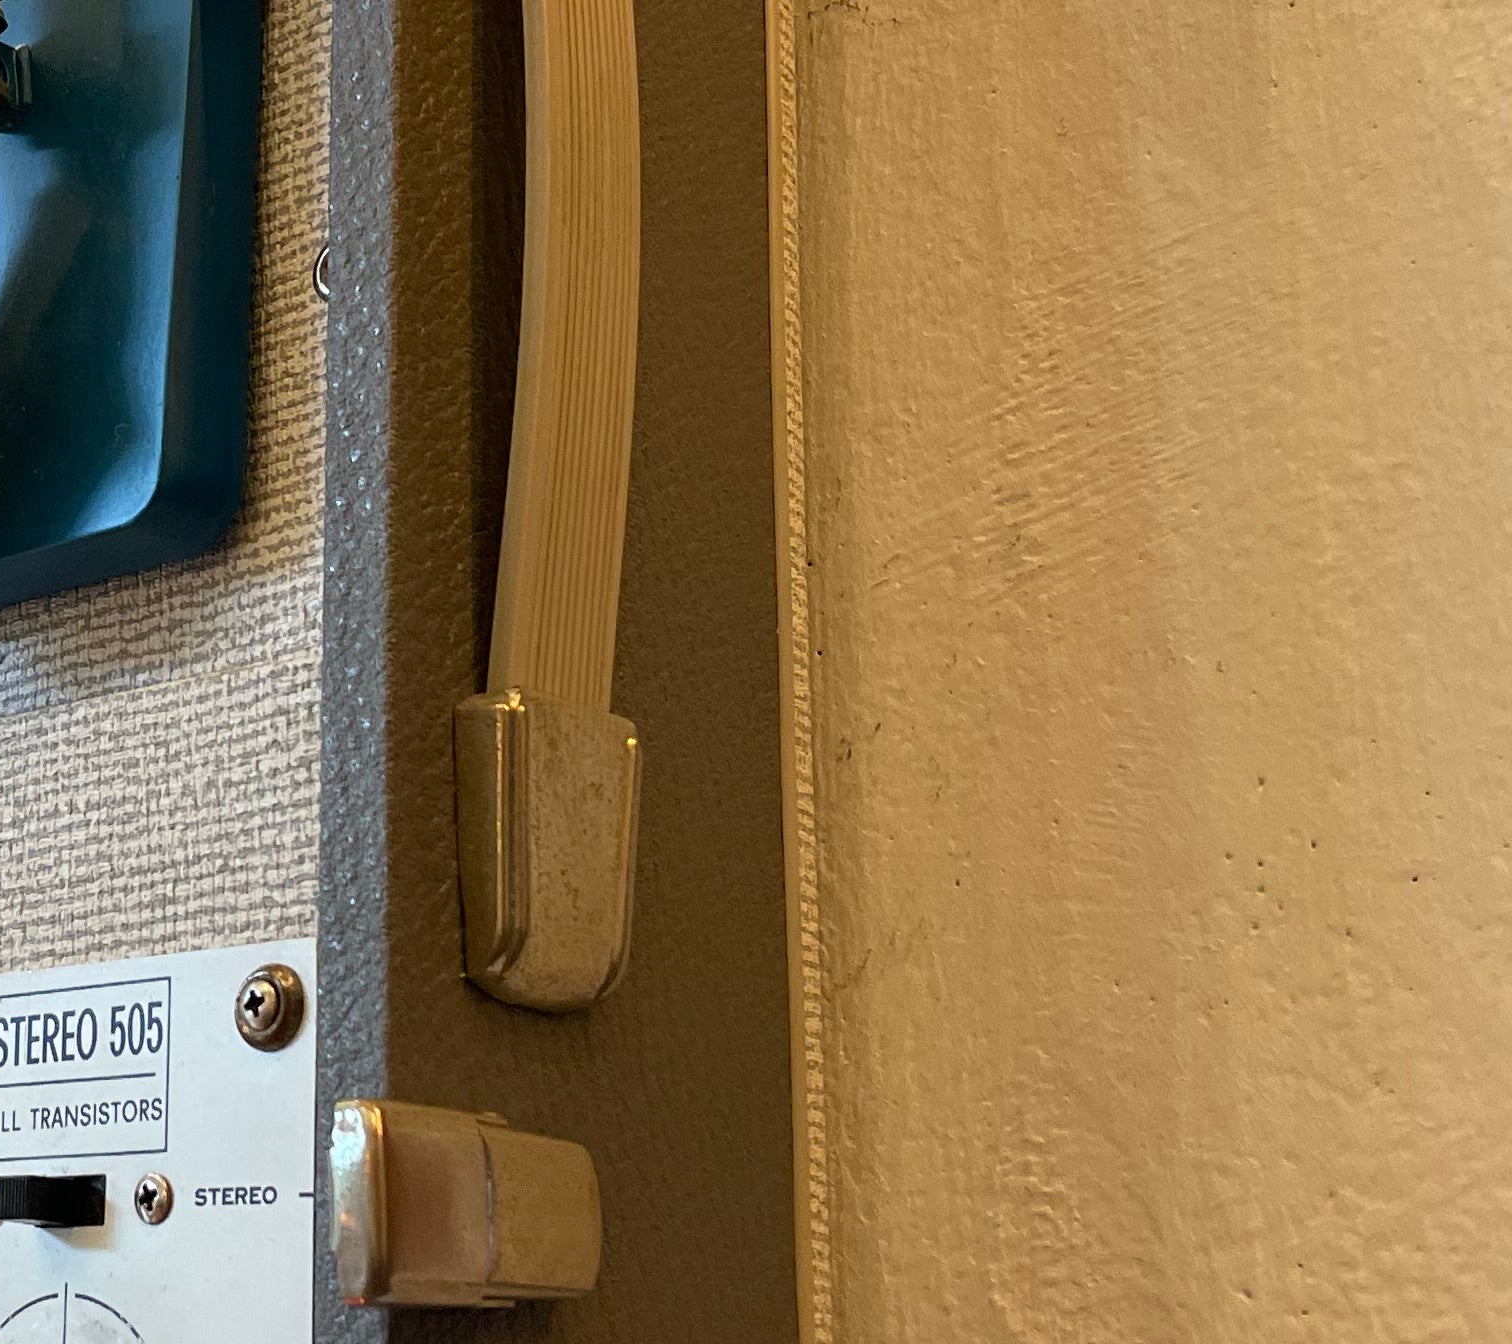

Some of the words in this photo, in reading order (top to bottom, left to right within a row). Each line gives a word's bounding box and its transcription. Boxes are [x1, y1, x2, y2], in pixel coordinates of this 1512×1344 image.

[109, 1000, 164, 1058] 505
[29, 1097, 163, 1131] TRANSISTORS
[193, 1185, 279, 1208] STEREO
